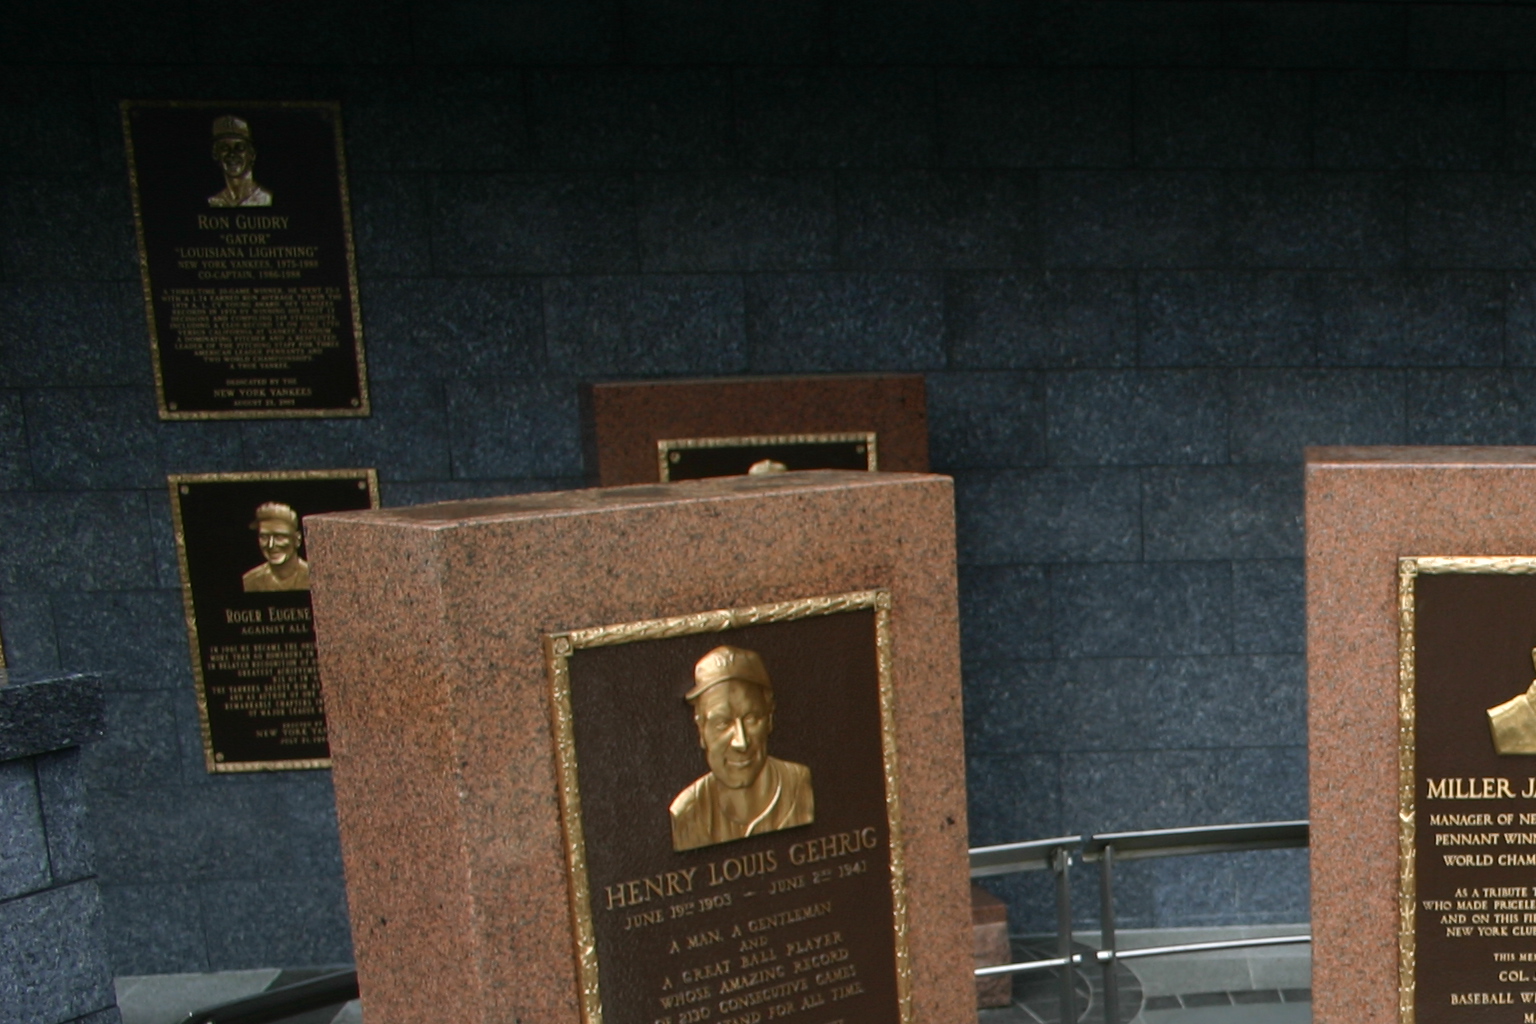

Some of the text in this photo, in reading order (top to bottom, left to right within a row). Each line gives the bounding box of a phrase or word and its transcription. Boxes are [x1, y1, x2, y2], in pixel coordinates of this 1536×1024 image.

[197, 214, 289, 230] RON GUIDRY
[219, 233, 271, 245] "GATOR"
[1427, 778, 1516, 799] MILLER
[1430, 813, 1494, 826] MANAGER
[1497, 813, 1514, 826] OF
[1435, 832, 1500, 846] PENNANT
[1443, 854, 1494, 867] WORLD
[1455, 887, 1468, 898] AS
[1471, 888, 1480, 898] A
[1482, 886, 1528, 898] TRIBUTE
[1422, 900, 1452, 911] WHO
[1456, 900, 1488, 911] MADE
[1440, 913, 1467, 924] AND
[1471, 913, 1490, 924] ON
[1493, 913, 1519, 924] THIS
[1446, 926, 1474, 937] NEW
[1477, 926, 1508, 937] YORK
[1493, 952, 1515, 962] THIS
[1498, 970, 1530, 982] COL.
[1451, 992, 1514, 1006] BASEBALL
